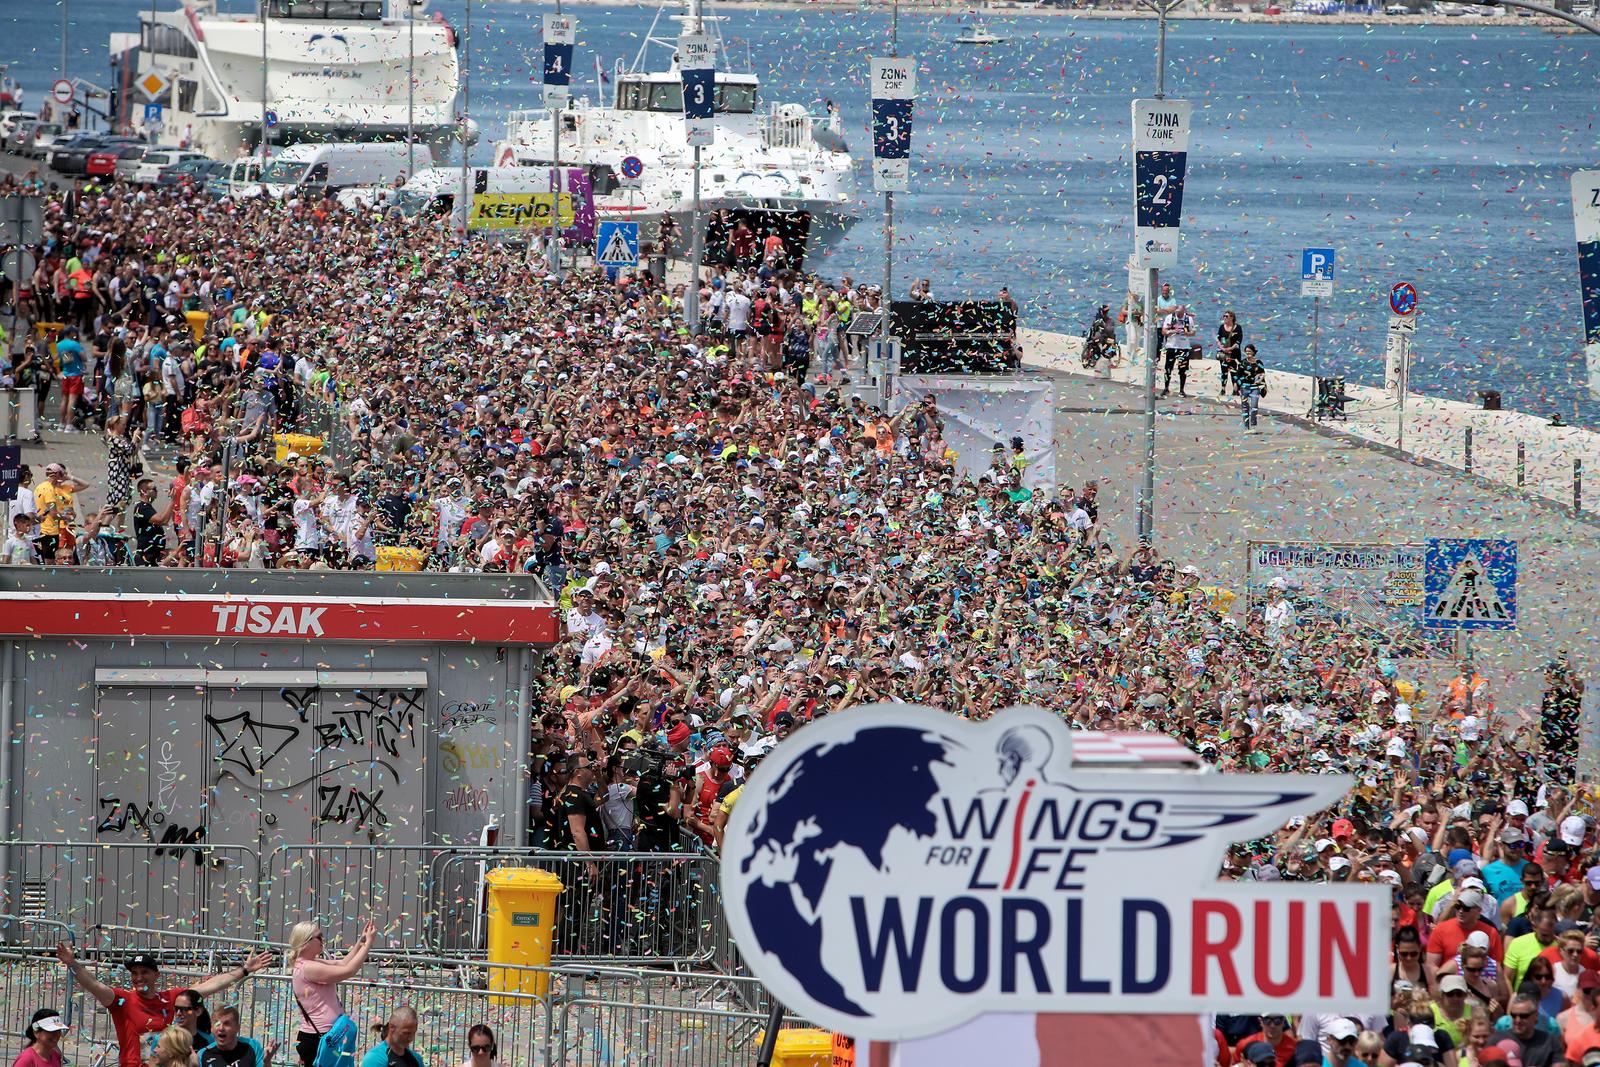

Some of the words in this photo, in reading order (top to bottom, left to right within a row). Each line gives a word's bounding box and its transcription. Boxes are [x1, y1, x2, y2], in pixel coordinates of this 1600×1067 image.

[551, 20, 570, 30] ZONA
[686, 43, 709, 54] ZONA
[881, 68, 907, 80] ZONA
[694, 83, 704, 104] 3
[148, 106, 158, 118] P
[1147, 112, 1179, 127] ZONA
[886, 116, 898, 141] 3
[1151, 129, 1174, 140] ZONE
[1152, 174, 1168, 205] 2
[478, 196, 561, 225] KEIND
[1311, 253, 1326, 274] P
[1, 468, 18, 480] TOILET
[211, 604, 328, 635] TISAK
[925, 846, 972, 867] FOR
[967, 846, 1100, 891] LIFE
[849, 895, 1172, 996] WORLD
[1190, 898, 1371, 999] RUN
